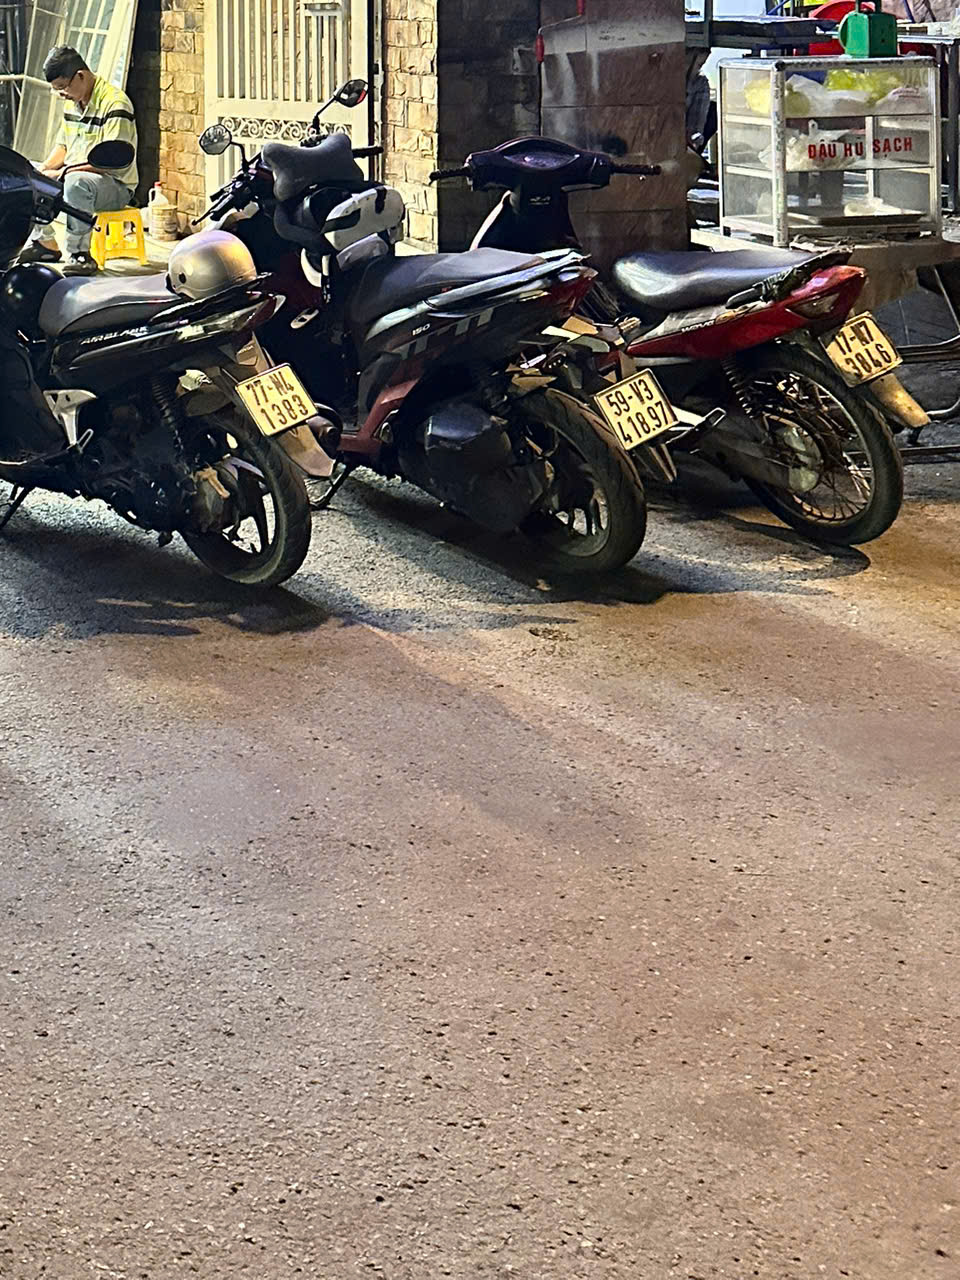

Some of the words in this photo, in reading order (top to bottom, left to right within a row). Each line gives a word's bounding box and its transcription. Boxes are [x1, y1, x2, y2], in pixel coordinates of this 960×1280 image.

[872, 137, 913, 158] SẠCH
[260, 394, 309, 430] 1383
[605, 378, 654, 417] 59-V3
[617, 400, 669, 444] 418.97
